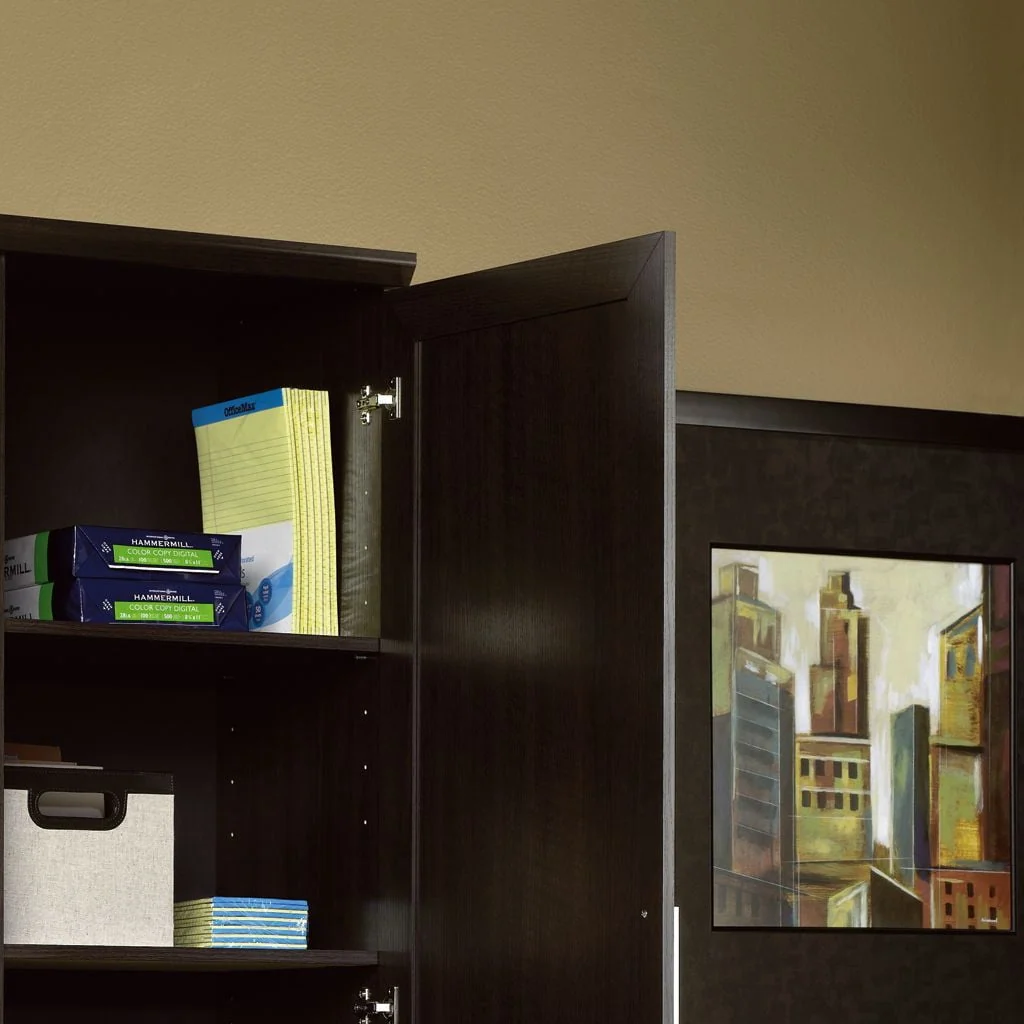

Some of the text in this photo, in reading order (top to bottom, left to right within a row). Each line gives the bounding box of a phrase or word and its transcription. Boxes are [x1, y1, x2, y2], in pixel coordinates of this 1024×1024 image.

[223, 401, 256, 417] OfficeMax
[127, 548, 199, 558] COLOR COPY DIGITAL
